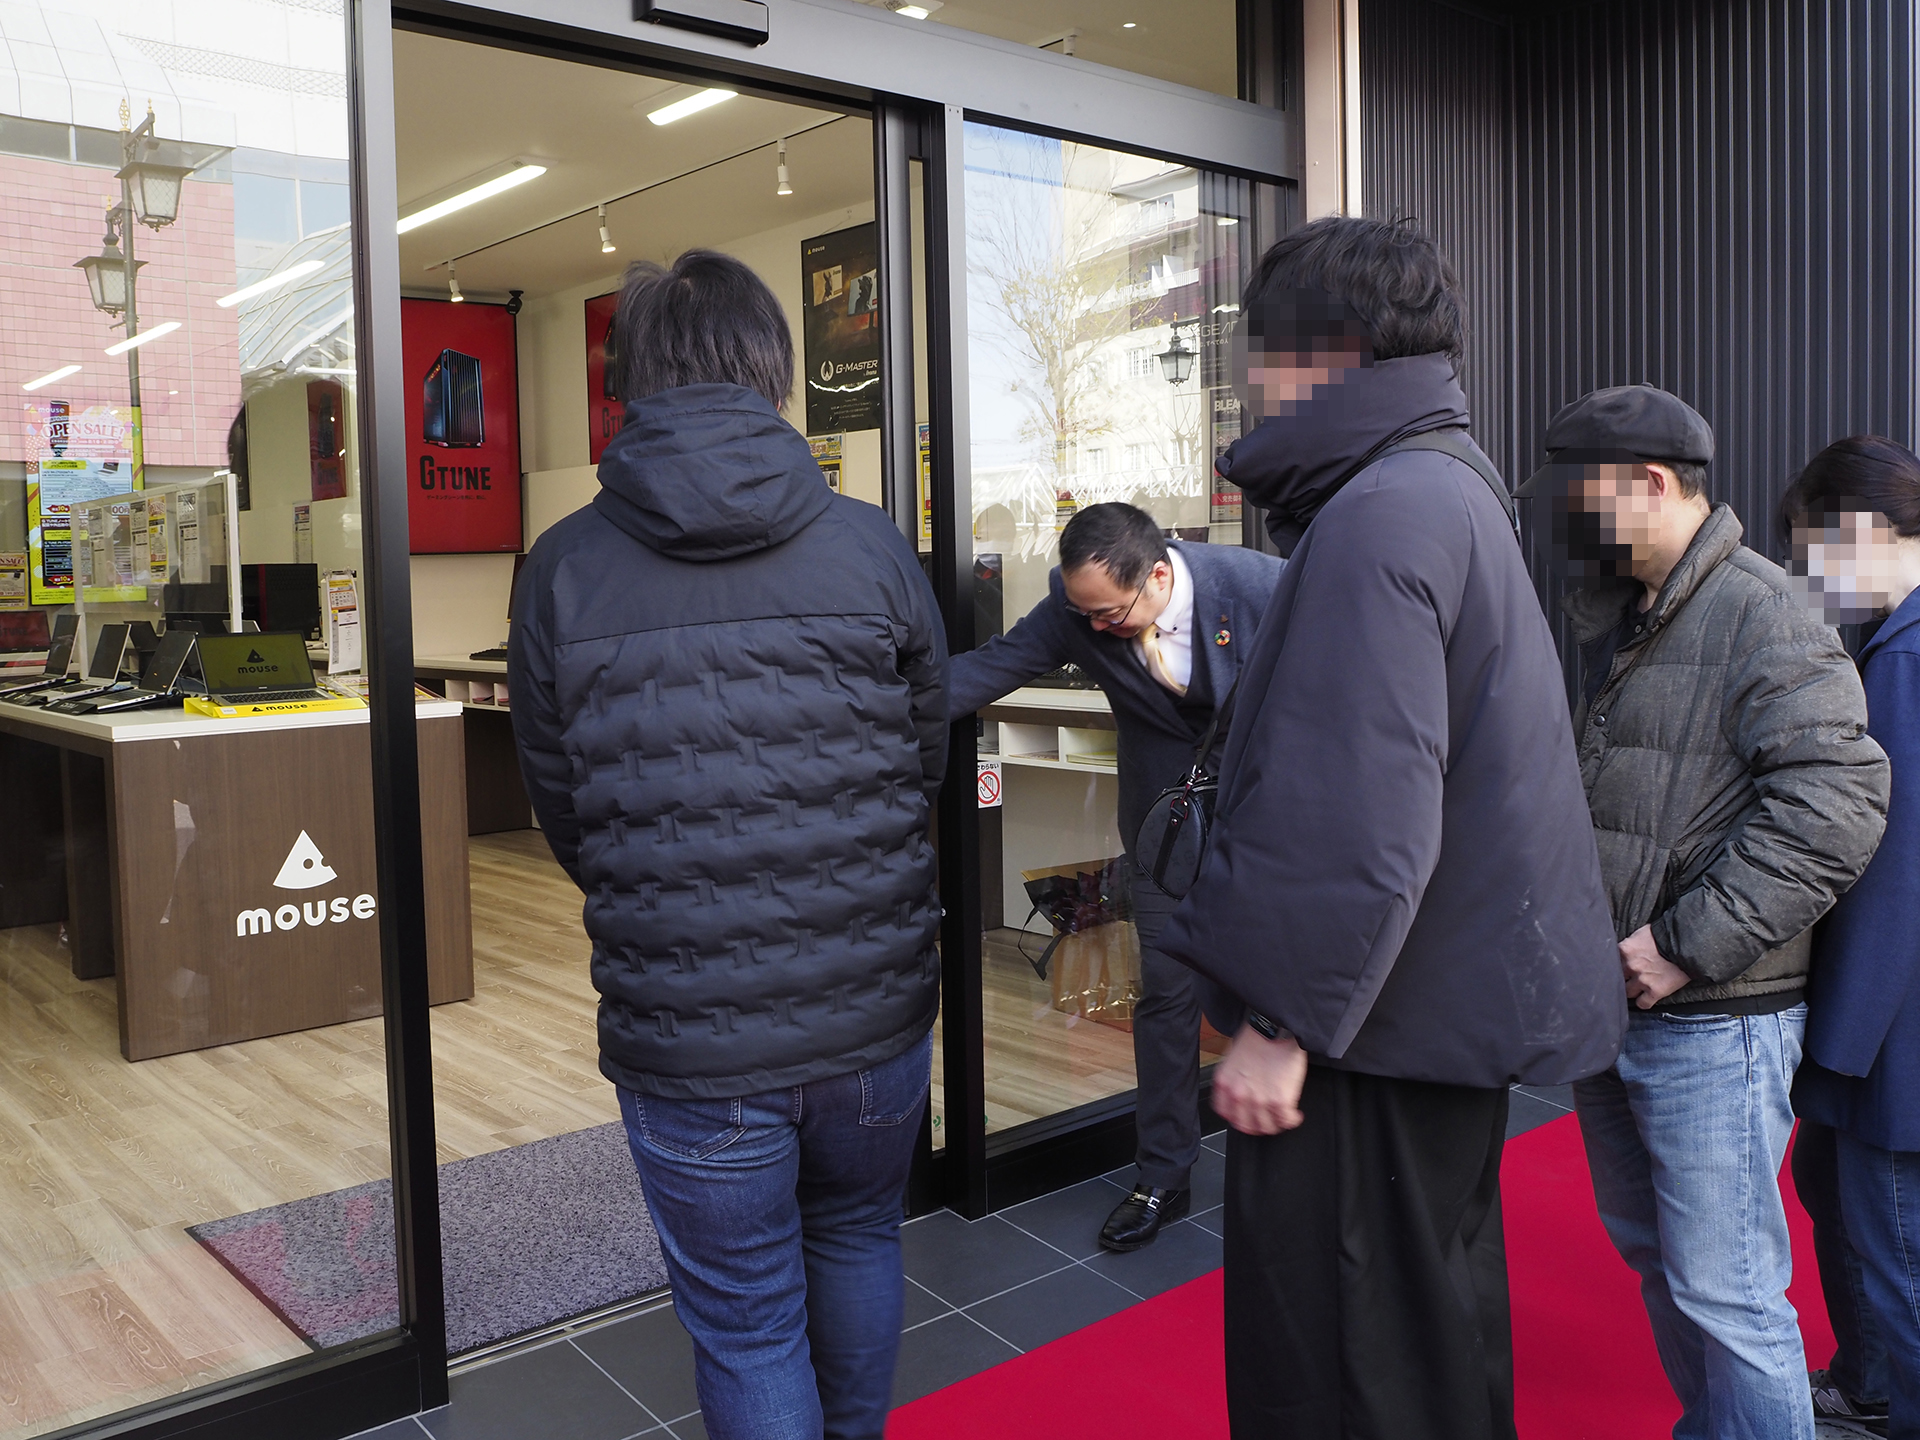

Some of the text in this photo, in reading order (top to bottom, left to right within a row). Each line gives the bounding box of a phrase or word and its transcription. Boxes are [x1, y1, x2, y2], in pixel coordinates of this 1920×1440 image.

[812, 245, 826, 254] mouse
[836, 360, 878, 374] G-MASTER
[38, 405, 65, 414] mouse
[42, 422, 125, 440] OPEN SALE!
[237, 664, 279, 675] mouse
[265, 703, 308, 711] mouse
[237, 893, 376, 937] mouse
